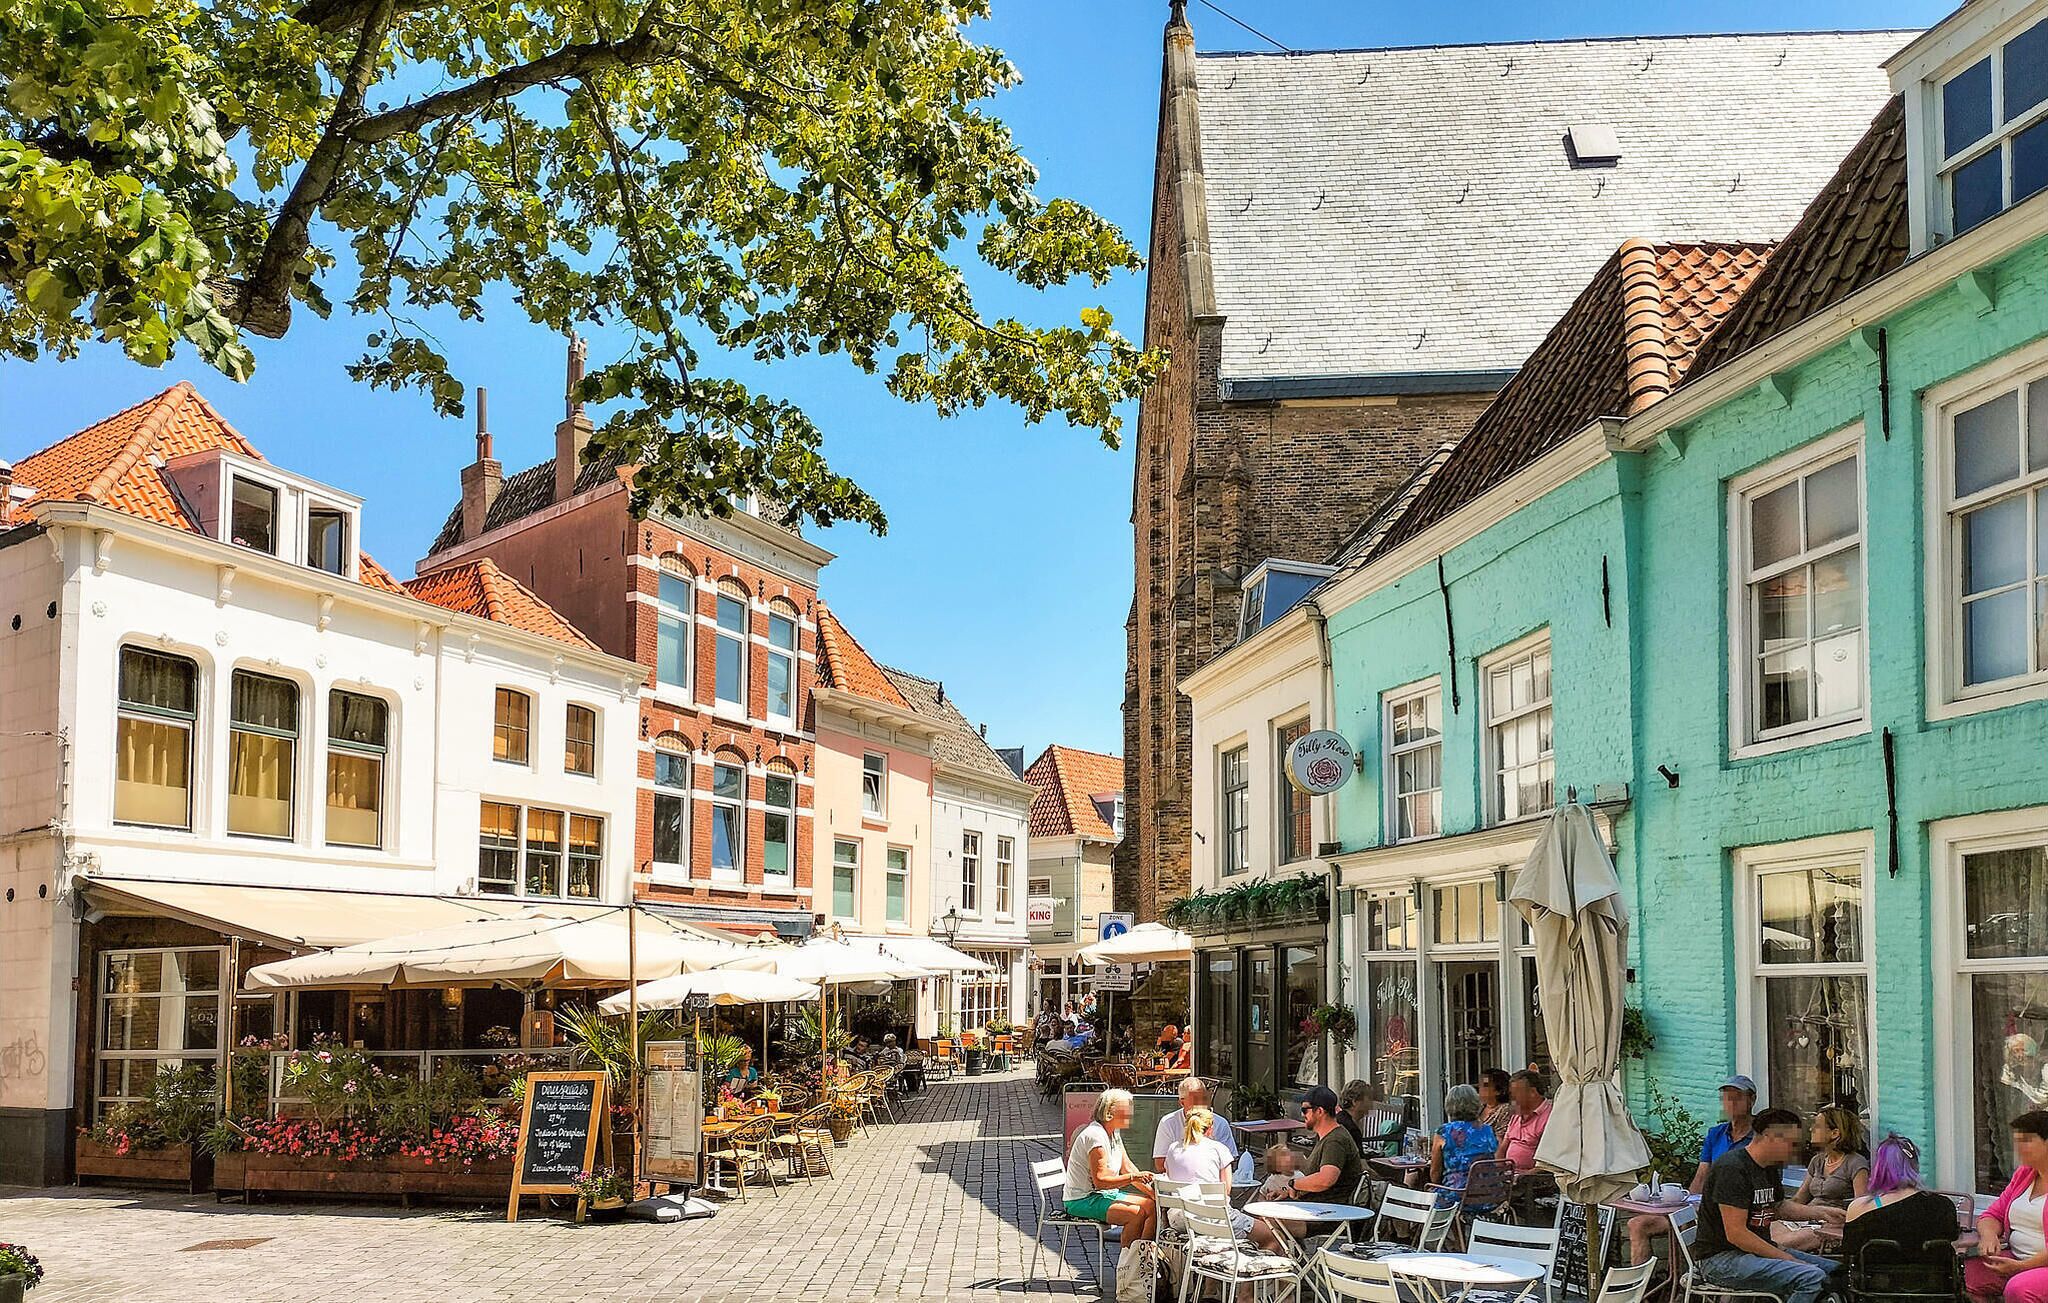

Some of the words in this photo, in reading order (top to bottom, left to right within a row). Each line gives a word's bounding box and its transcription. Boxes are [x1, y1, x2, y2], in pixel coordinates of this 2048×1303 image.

[1298, 738, 1320, 757] Tilly
[1323, 739, 1349, 757] Rose
[1029, 911, 1051, 921] KING
[1376, 976, 1396, 1010] Tilly
